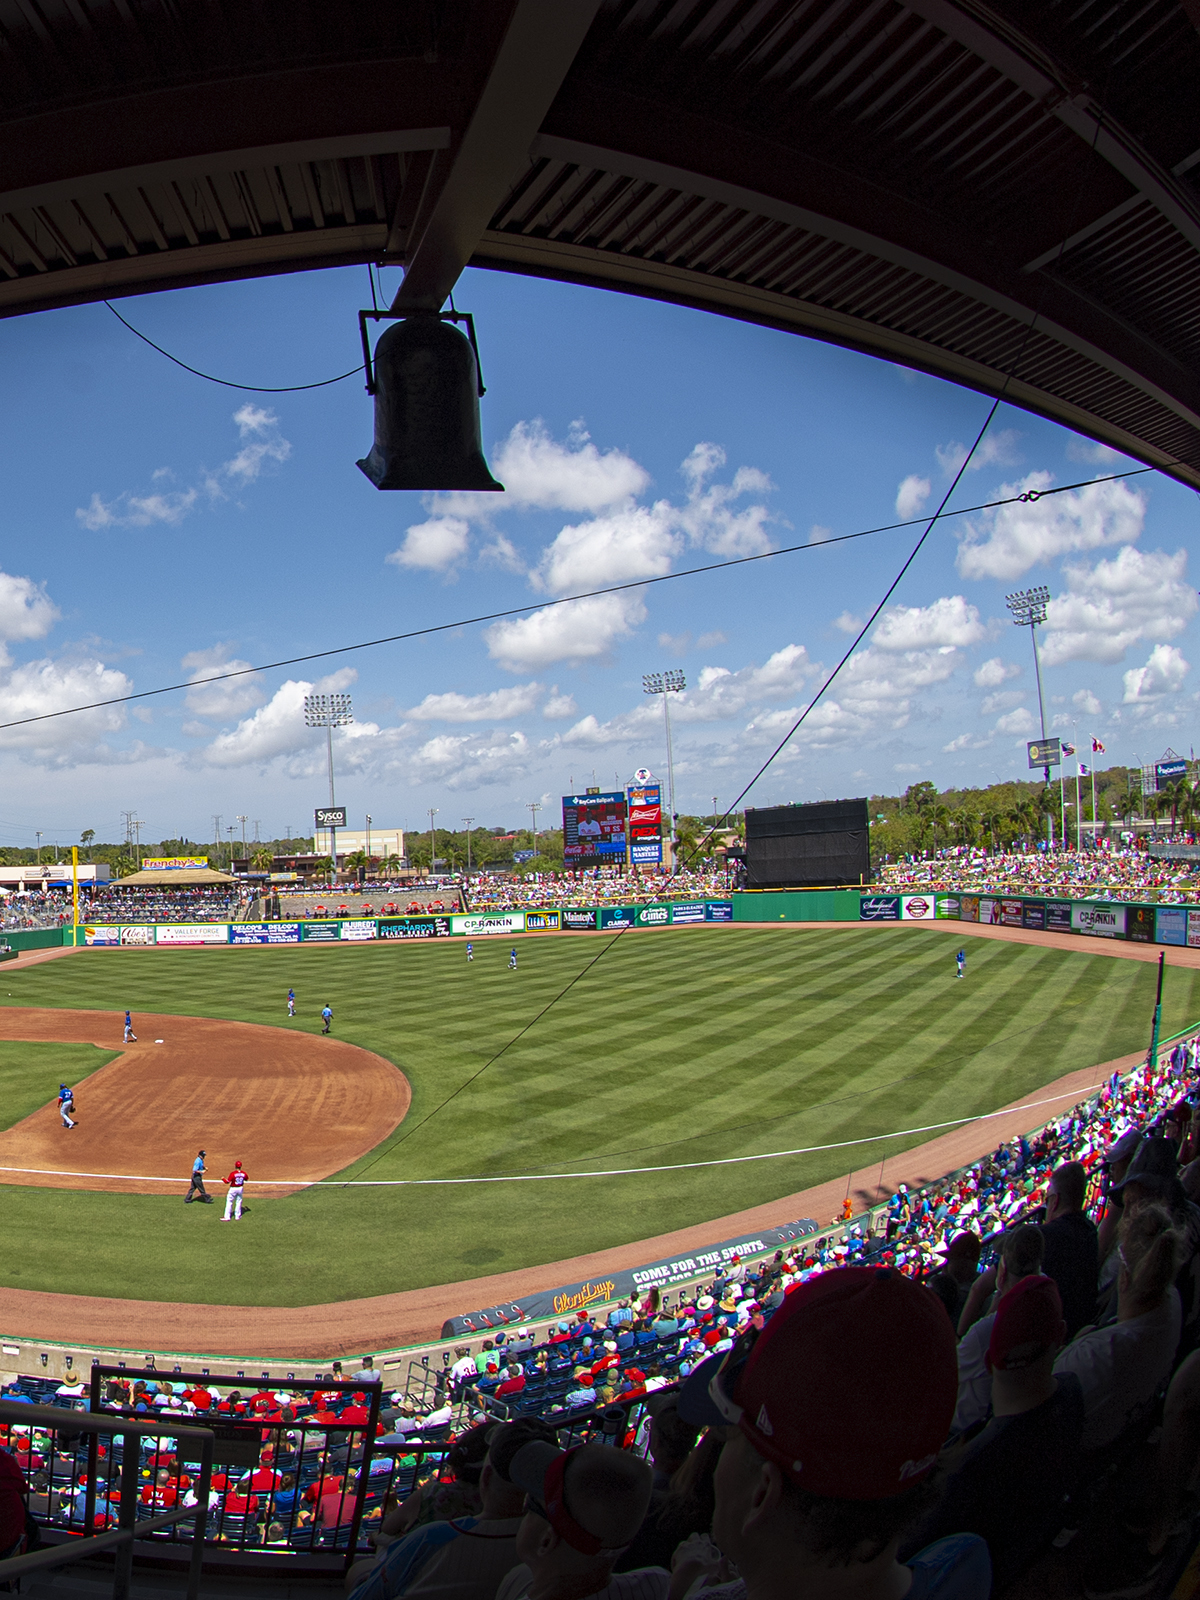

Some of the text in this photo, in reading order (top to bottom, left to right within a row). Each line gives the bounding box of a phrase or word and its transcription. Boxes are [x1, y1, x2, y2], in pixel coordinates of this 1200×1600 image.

[317, 810, 344, 822] Sysco
[631, 827, 658, 838] DEX
[143, 858, 196, 868] Frenchy's
[640, 909, 669, 922] Times
[380, 923, 435, 933] SHEPHARD'S
[632, 1239, 768, 1284] COME FOR THE SPORTS.
[584, 1279, 615, 1302] Days
